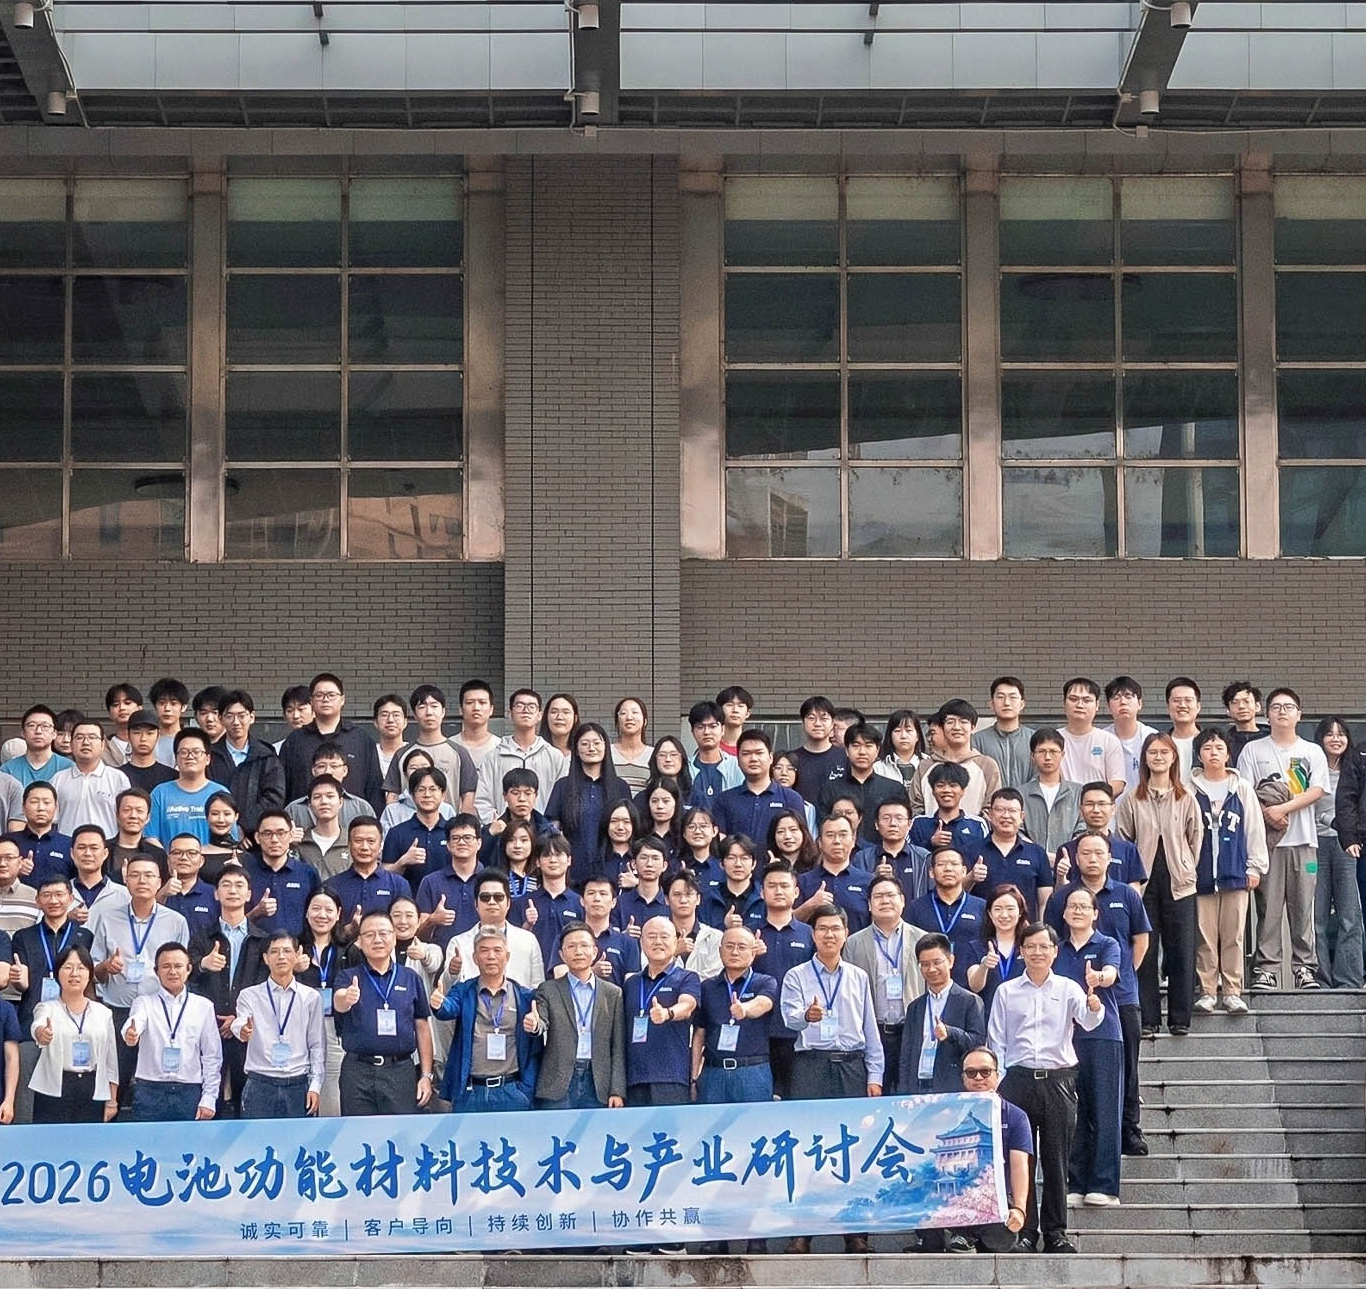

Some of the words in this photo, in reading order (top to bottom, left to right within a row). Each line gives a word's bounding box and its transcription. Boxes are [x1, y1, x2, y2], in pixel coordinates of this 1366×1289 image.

[1, 1116, 925, 1207] 2026电池功能材料技术与产业研讨会
[239, 1220, 330, 1240] 诚实可靠
[363, 1216, 454, 1237] 客户导向
[487, 1212, 578, 1233] 持续创新
[611, 1206, 702, 1229] 协作共赢
